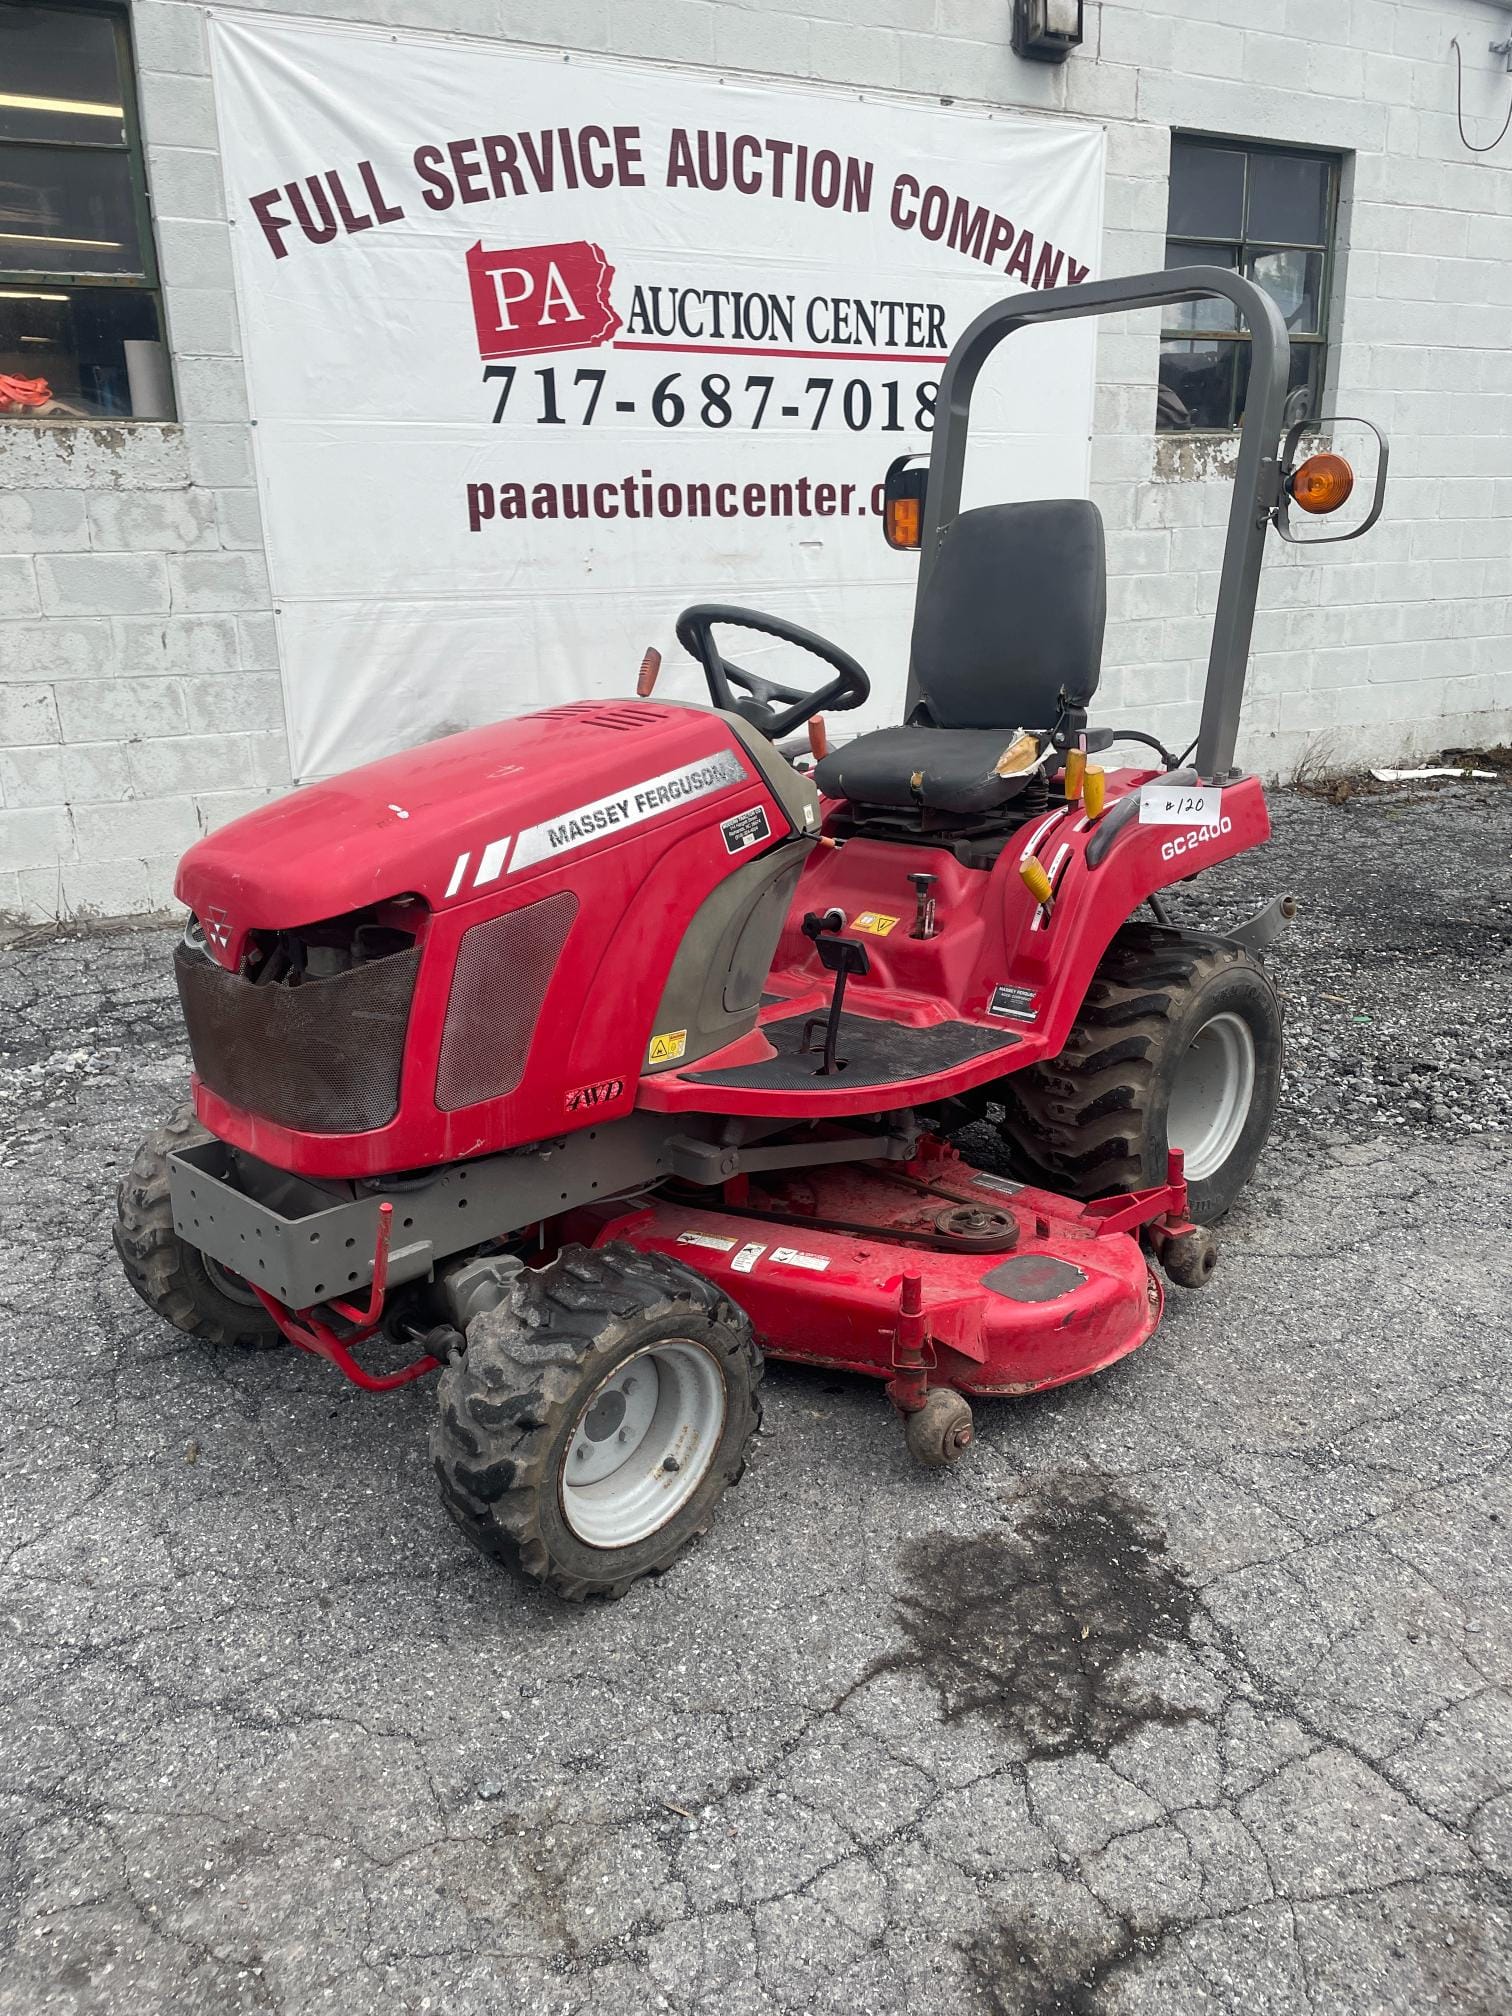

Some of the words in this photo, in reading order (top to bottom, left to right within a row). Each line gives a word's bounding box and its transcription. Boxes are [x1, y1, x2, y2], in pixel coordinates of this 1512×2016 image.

[249, 160, 405, 260] FULL
[413, 125, 646, 212] SERVICE
[666, 128, 874, 213] AUCTION
[890, 173, 1090, 291] COMPANY
[485, 261, 585, 332] PA
[627, 285, 793, 342] AUCTION
[806, 296, 948, 349] CENTER
[481, 365, 939, 432] 717-687-7018
[466, 469, 886, 532] paauctioncenter.c
[548, 800, 629, 848] MASSEY
[634, 764, 728, 813] FERGUSON
[1161, 816, 1232, 861] GC2400
